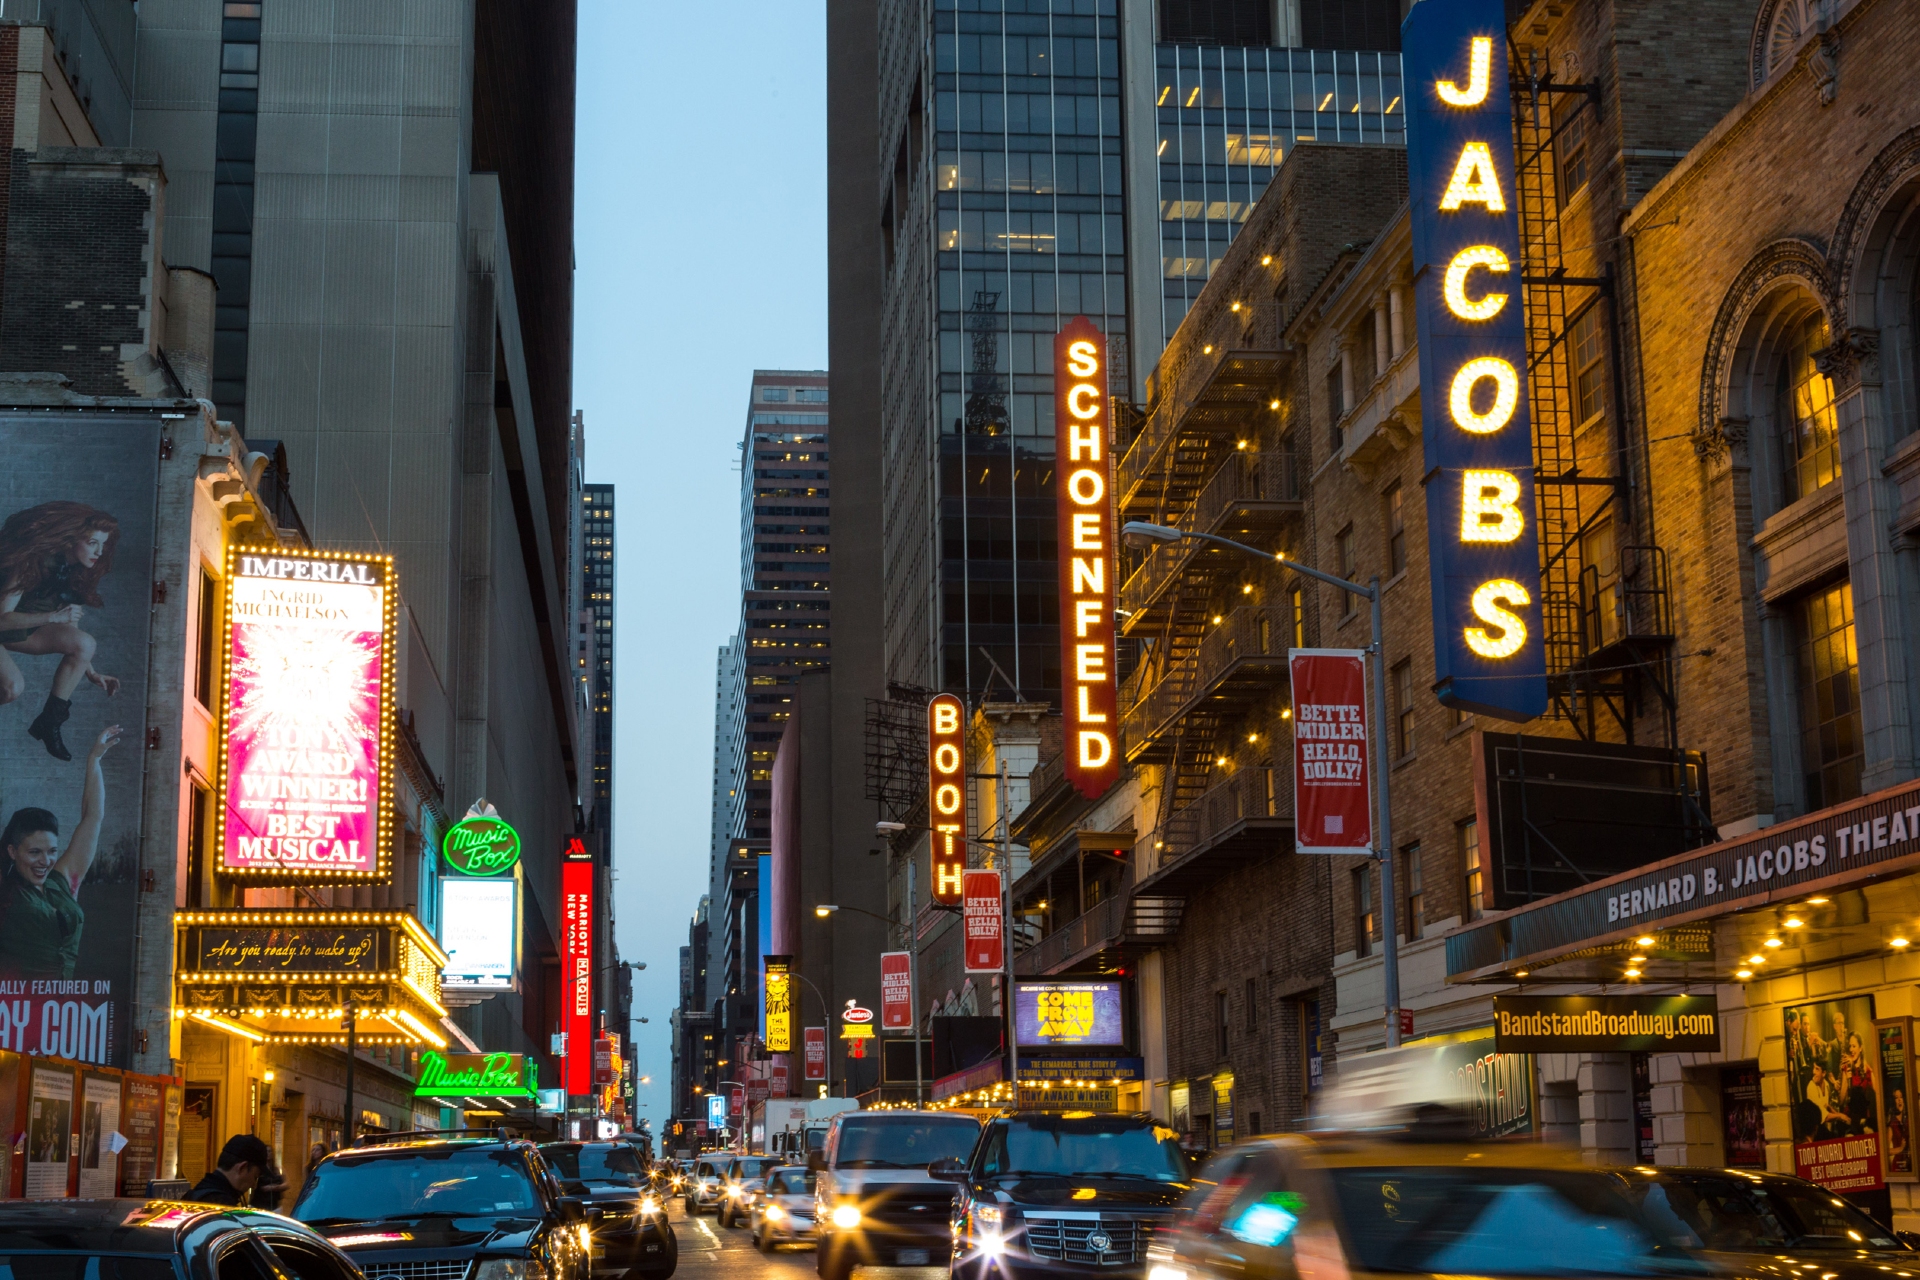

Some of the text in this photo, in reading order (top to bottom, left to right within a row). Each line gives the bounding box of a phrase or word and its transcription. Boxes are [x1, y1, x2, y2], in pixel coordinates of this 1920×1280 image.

[1436, 36, 1531, 659] JACOBS
[1067, 340, 1111, 768] SCHOENFELD
[241, 557, 375, 584] IMPERIAL
[262, 589, 323, 605] INGRID
[1300, 704, 1360, 722] BETTE
[267, 725, 341, 749] TONY
[1297, 722, 1365, 740] MIDLER
[1302, 743, 1362, 763] HELLO,
[1302, 762, 1362, 780] DOLLY!
[241, 774, 368, 802] WINNER!
[935, 703, 962, 895] BOOTH
[267, 814, 340, 838] BEST
[453, 825, 509, 850] Music
[238, 837, 366, 863] MUSICAL
[463, 845, 514, 869] Box
[1608, 873, 1696, 923] BERNARD
[1704, 867, 1725, 896] B.
[1731, 834, 1826, 888] JACOBS
[567, 894, 576, 920] NEW
[965, 906, 1001, 916] MIDLER
[967, 897, 998, 907] BETTE
[968, 926, 999, 937] DOLLY!
[207, 939, 237, 957] Are
[234, 944, 261, 966] you
[300, 944, 311, 956] to
[578, 894, 588, 1014] MARRIOTT MARQUIS
[882, 979, 910, 987] MIDLER
[884, 972, 908, 980] BETTE
[31, 980, 89, 995] FEATURED
[94, 980, 111, 995] ON
[1037, 991, 1094, 1007] COME
[1037, 1006, 1094, 1022] FROM
[1037, 1021, 1094, 1037] AWAY
[1501, 1010, 1714, 1039] BandstandBroadway.com
[768, 1036, 788, 1048] KING
[419, 1051, 519, 1087] Music Box
[1024, 1069, 1041, 1077] SMALL
[1060, 1069, 1072, 1077] THAT
[1073, 1069, 1104, 1077] WELCOMED
[1042, 1060, 1077, 1068] REMARKABLE
[1078, 1060, 1091, 1068] TRUE
[1092, 1060, 1109, 1068] STORY
[1110, 1060, 1117, 1068] OF
[1021, 1090, 1112, 1101] TONY AWARD WINNER!
[1798, 1137, 1877, 1166] TONY AWARD WINNER!
[1811, 1160, 1868, 1180] BEST CHOREOGRAPHY
